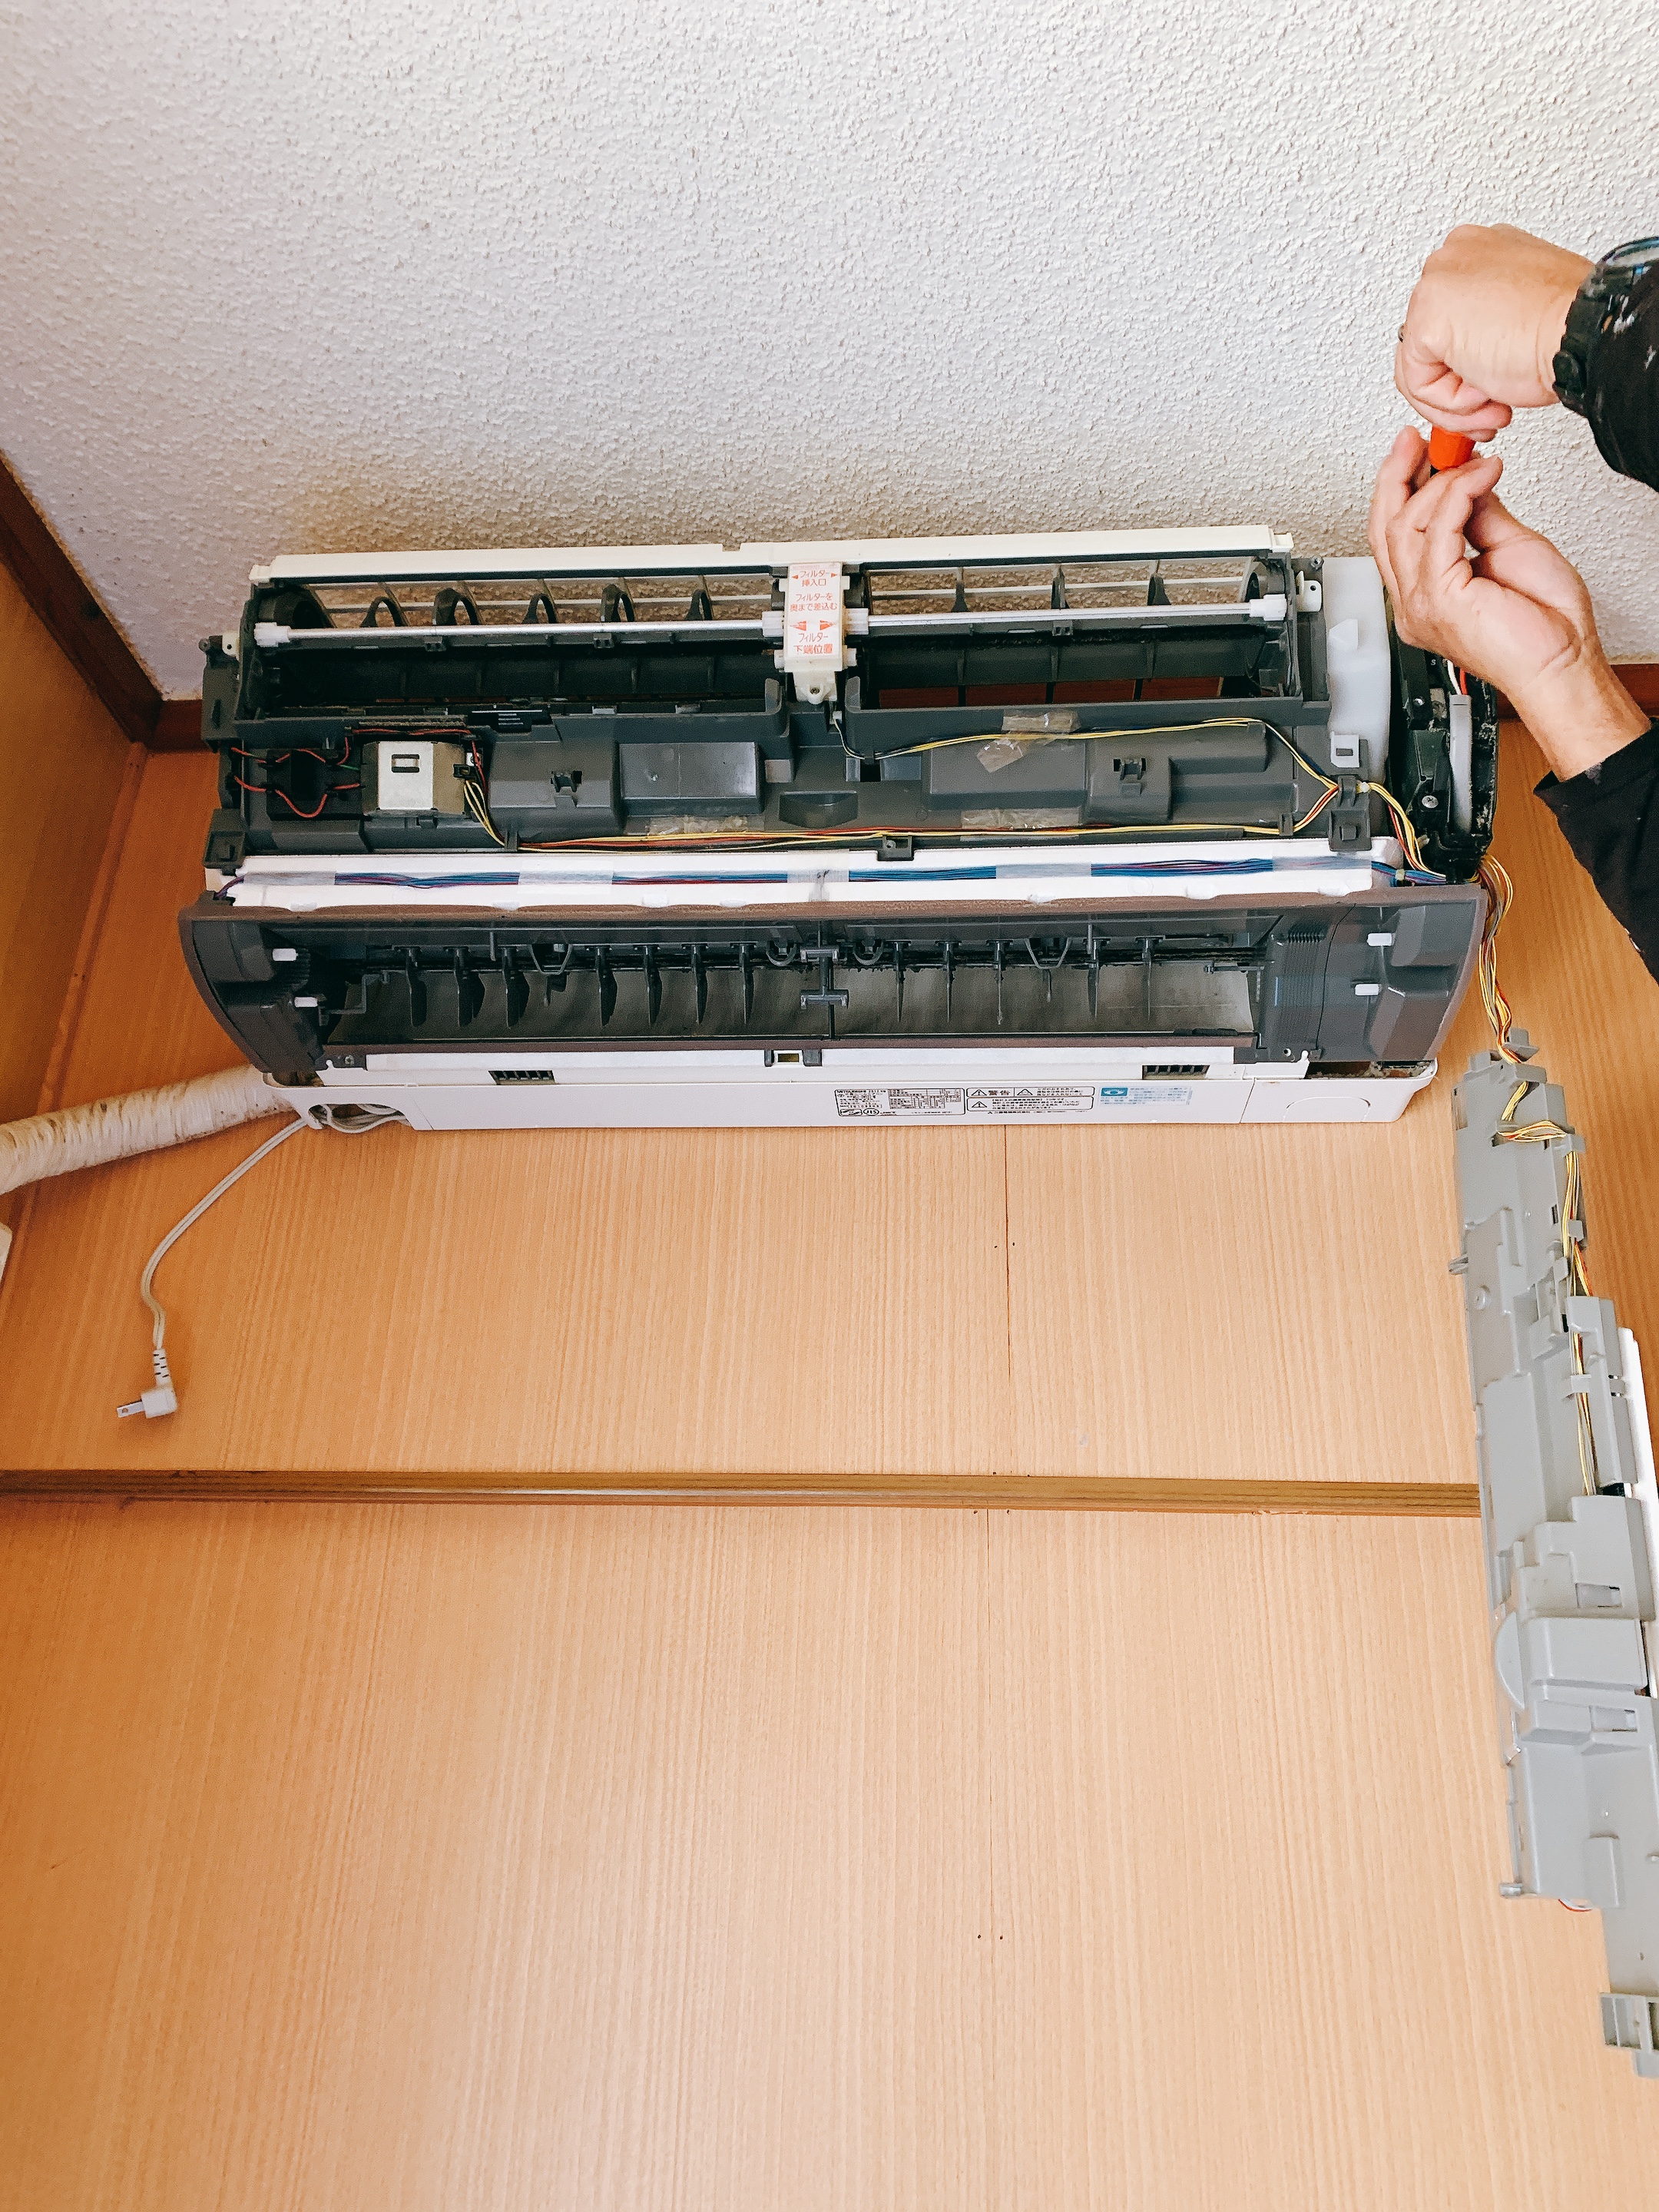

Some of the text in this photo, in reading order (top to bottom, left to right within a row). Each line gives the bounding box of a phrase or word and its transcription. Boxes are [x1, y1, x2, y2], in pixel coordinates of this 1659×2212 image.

[800, 570, 830, 578] フィルター
[802, 578, 826, 587] 挿入口
[796, 593, 833, 601] フィルターを
[790, 603, 837, 612] 奥まで差込む
[798, 632, 828, 643] フィルター
[793, 644, 833, 654] 下端位置
